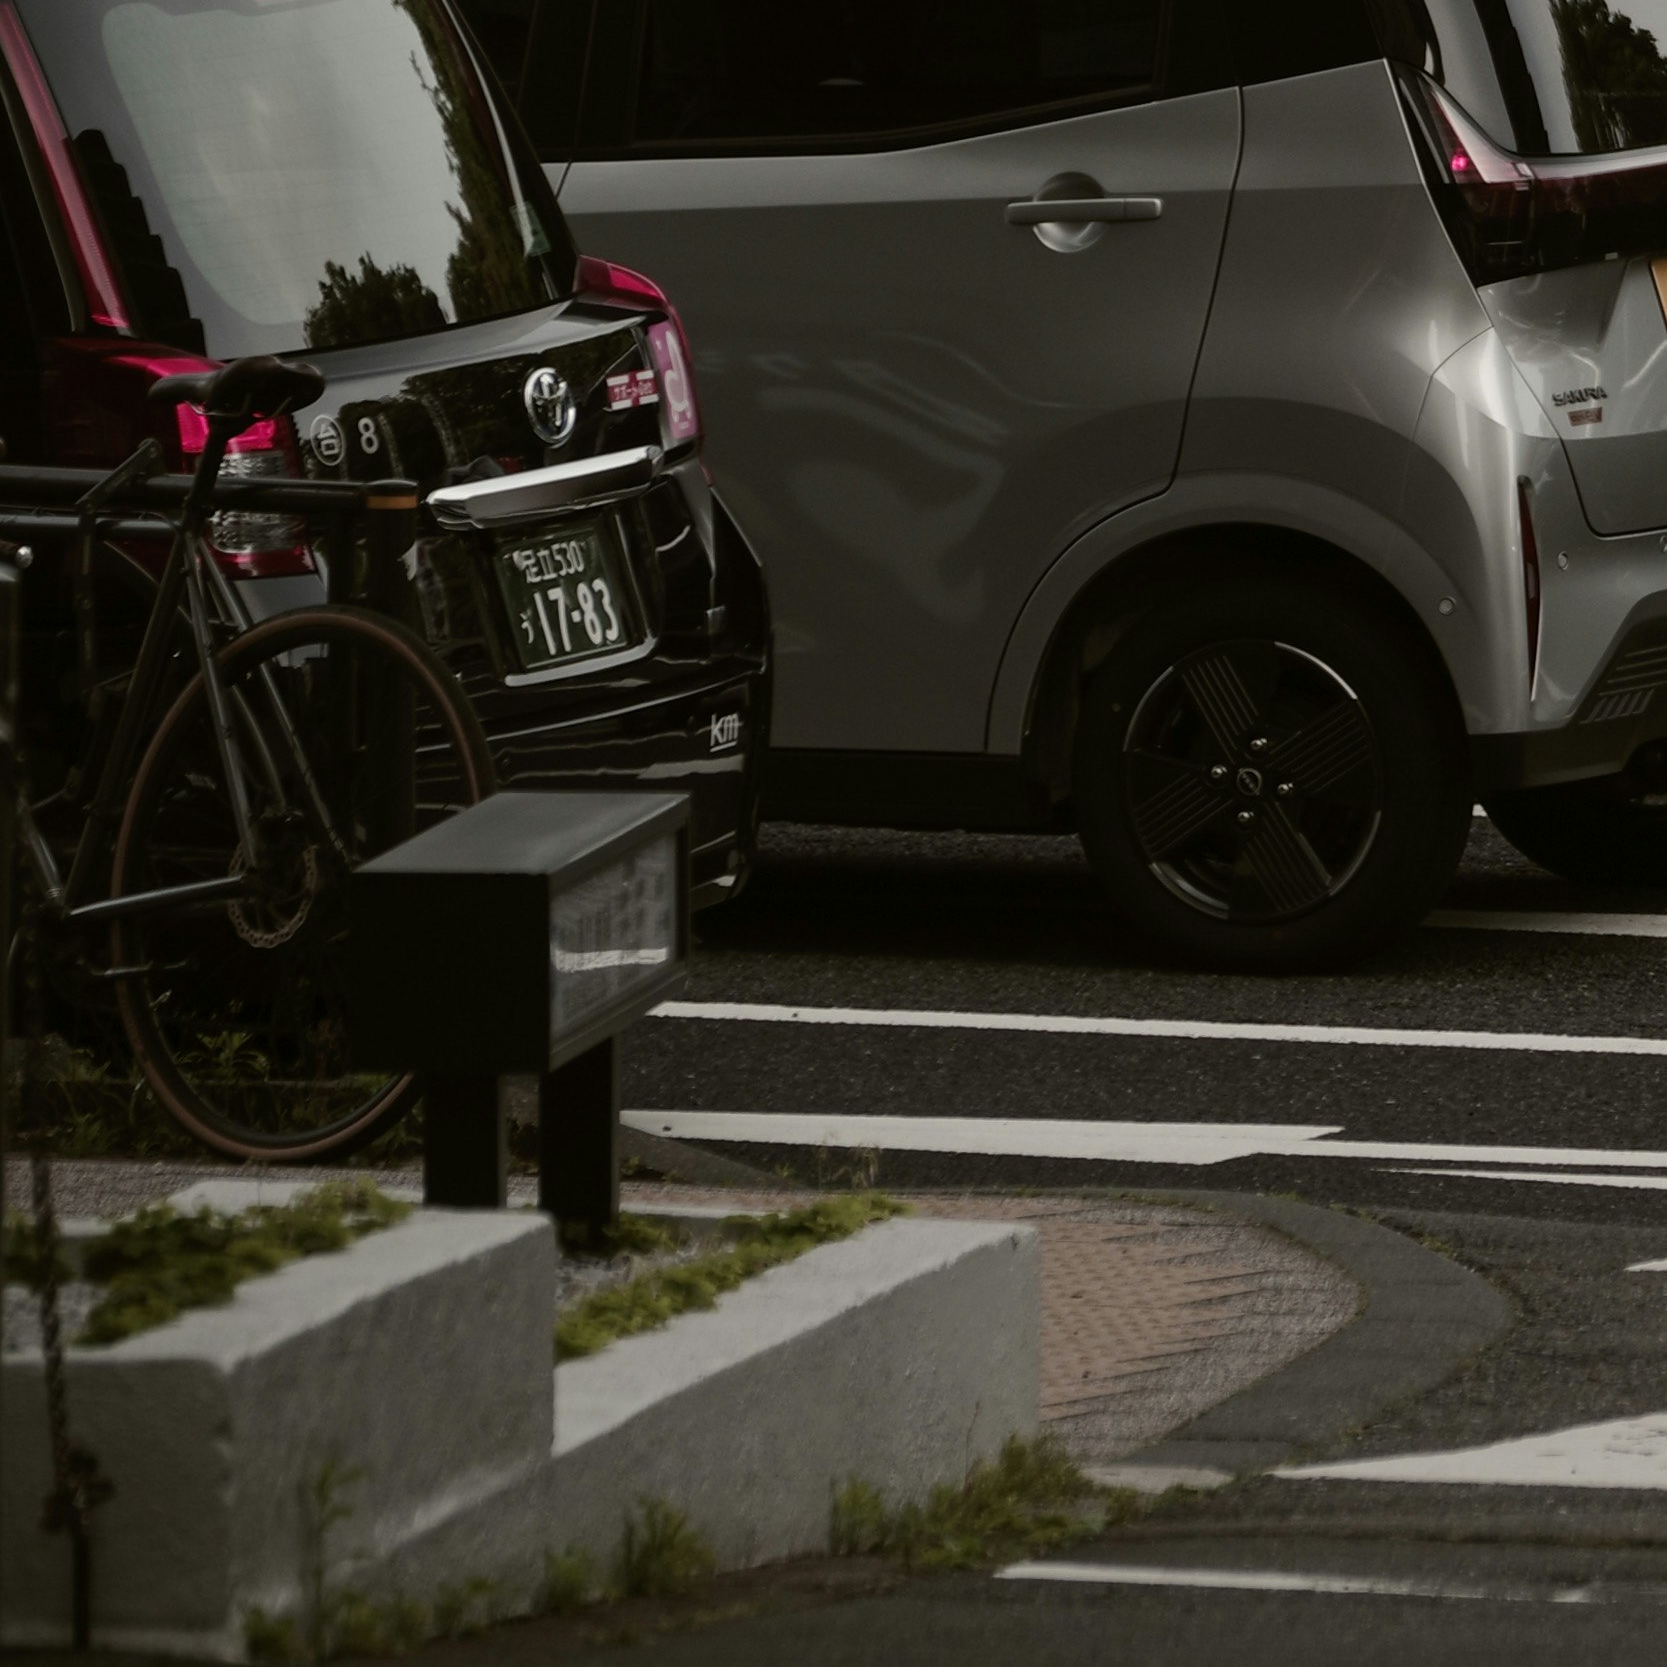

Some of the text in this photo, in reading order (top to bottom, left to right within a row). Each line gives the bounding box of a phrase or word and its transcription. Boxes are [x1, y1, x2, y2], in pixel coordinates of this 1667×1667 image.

[1552, 386, 1608, 407] SAKURA
[357, 416, 380, 455] 8
[519, 577, 620, 656] う 17-83
[710, 712, 741, 747] km
